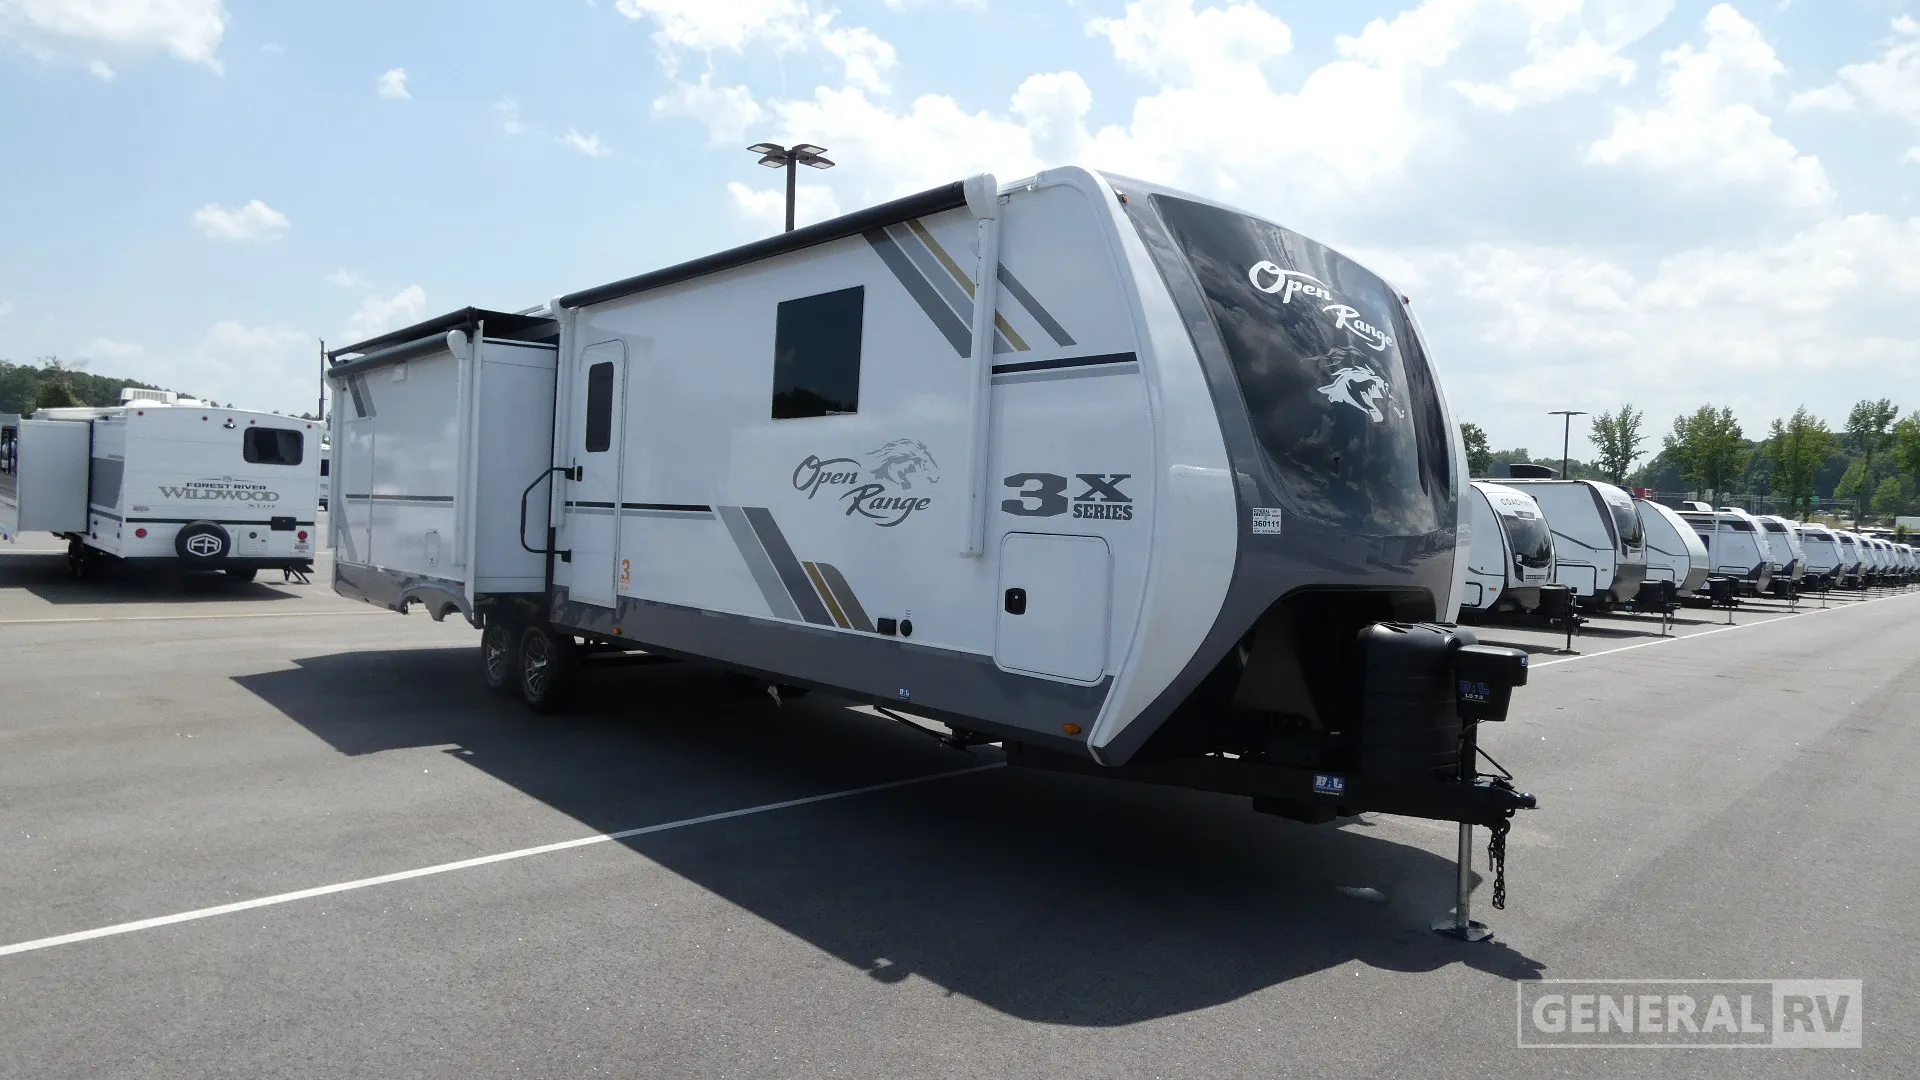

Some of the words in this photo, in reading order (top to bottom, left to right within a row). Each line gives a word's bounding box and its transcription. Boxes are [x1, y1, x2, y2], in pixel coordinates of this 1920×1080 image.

[1249, 260, 1332, 304] Open
[1322, 304, 1394, 352] Range
[158, 486, 280, 502] WILDWOOD
[792, 454, 862, 500] Open
[838, 483, 932, 528] Range
[1072, 503, 1133, 521] SERIES
[1253, 520, 1280, 528] 360111
